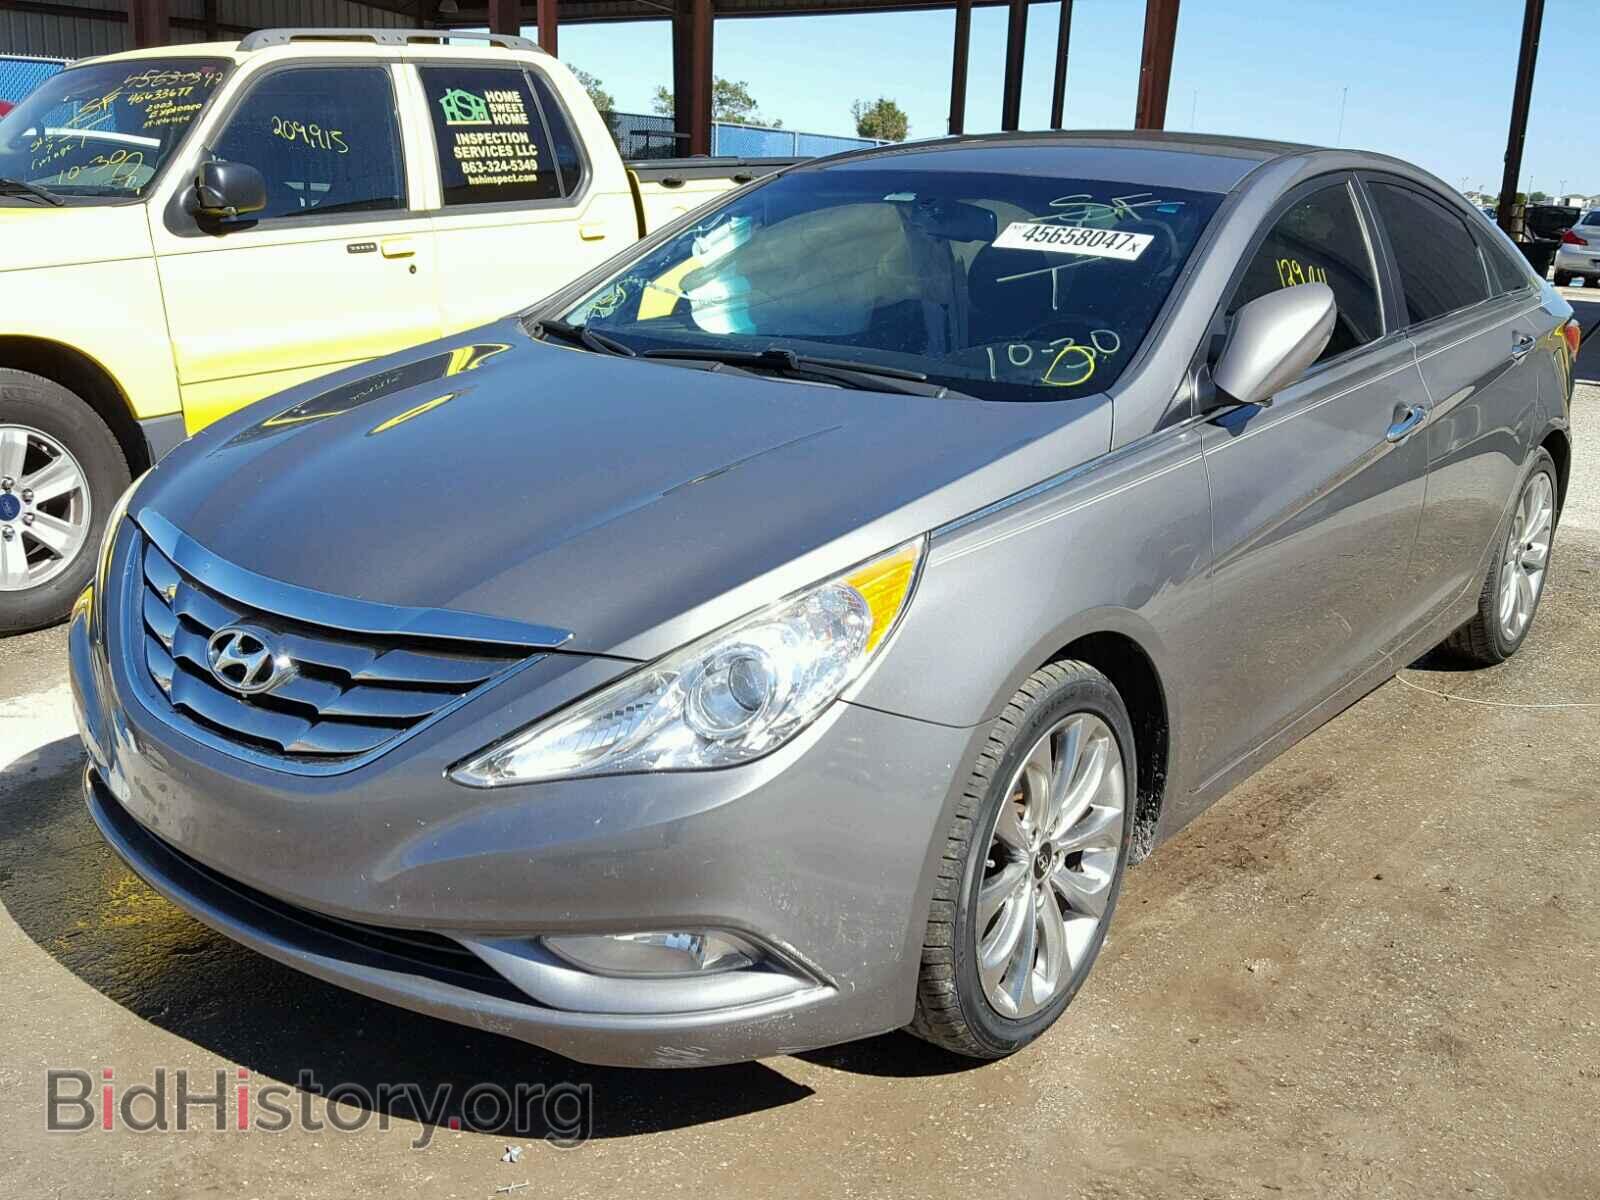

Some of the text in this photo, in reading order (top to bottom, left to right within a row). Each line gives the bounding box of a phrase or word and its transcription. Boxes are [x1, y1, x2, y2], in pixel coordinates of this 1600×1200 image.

[484, 90, 522, 103] HOME
[488, 103, 525, 113] SWEET
[492, 113, 530, 125] HOME
[455, 132, 530, 145] INSPECTION
[453, 144, 538, 159] SERVICES LLC
[461, 159, 538, 174] 863-324-5349
[467, 174, 538, 185] hshinspect.com
[1021, 225, 1135, 250] 45658047
